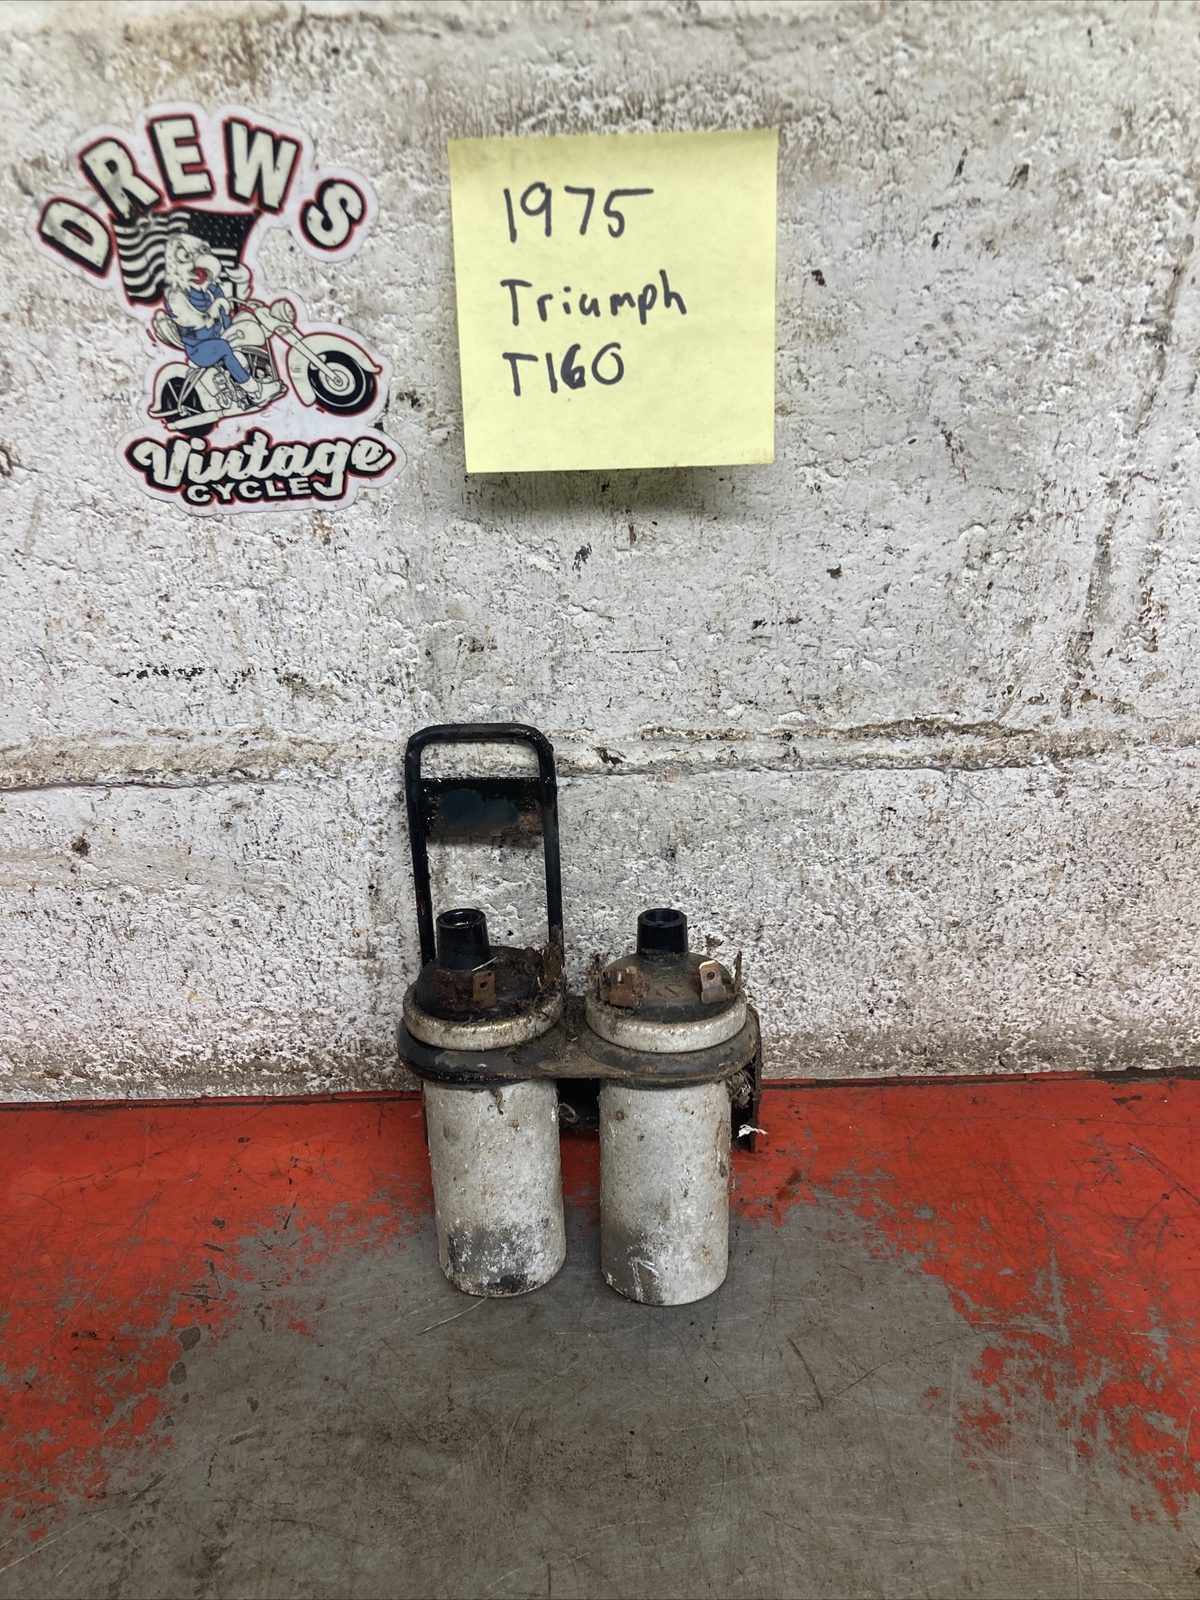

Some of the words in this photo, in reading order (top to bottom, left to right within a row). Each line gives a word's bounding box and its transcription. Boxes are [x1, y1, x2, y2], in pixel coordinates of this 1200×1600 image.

[40, 115, 364, 278] DREWS
[502, 181, 655, 243] 1975
[500, 269, 687, 326] Triumph
[502, 342, 625, 397] T160
[128, 428, 394, 499] Vintage
